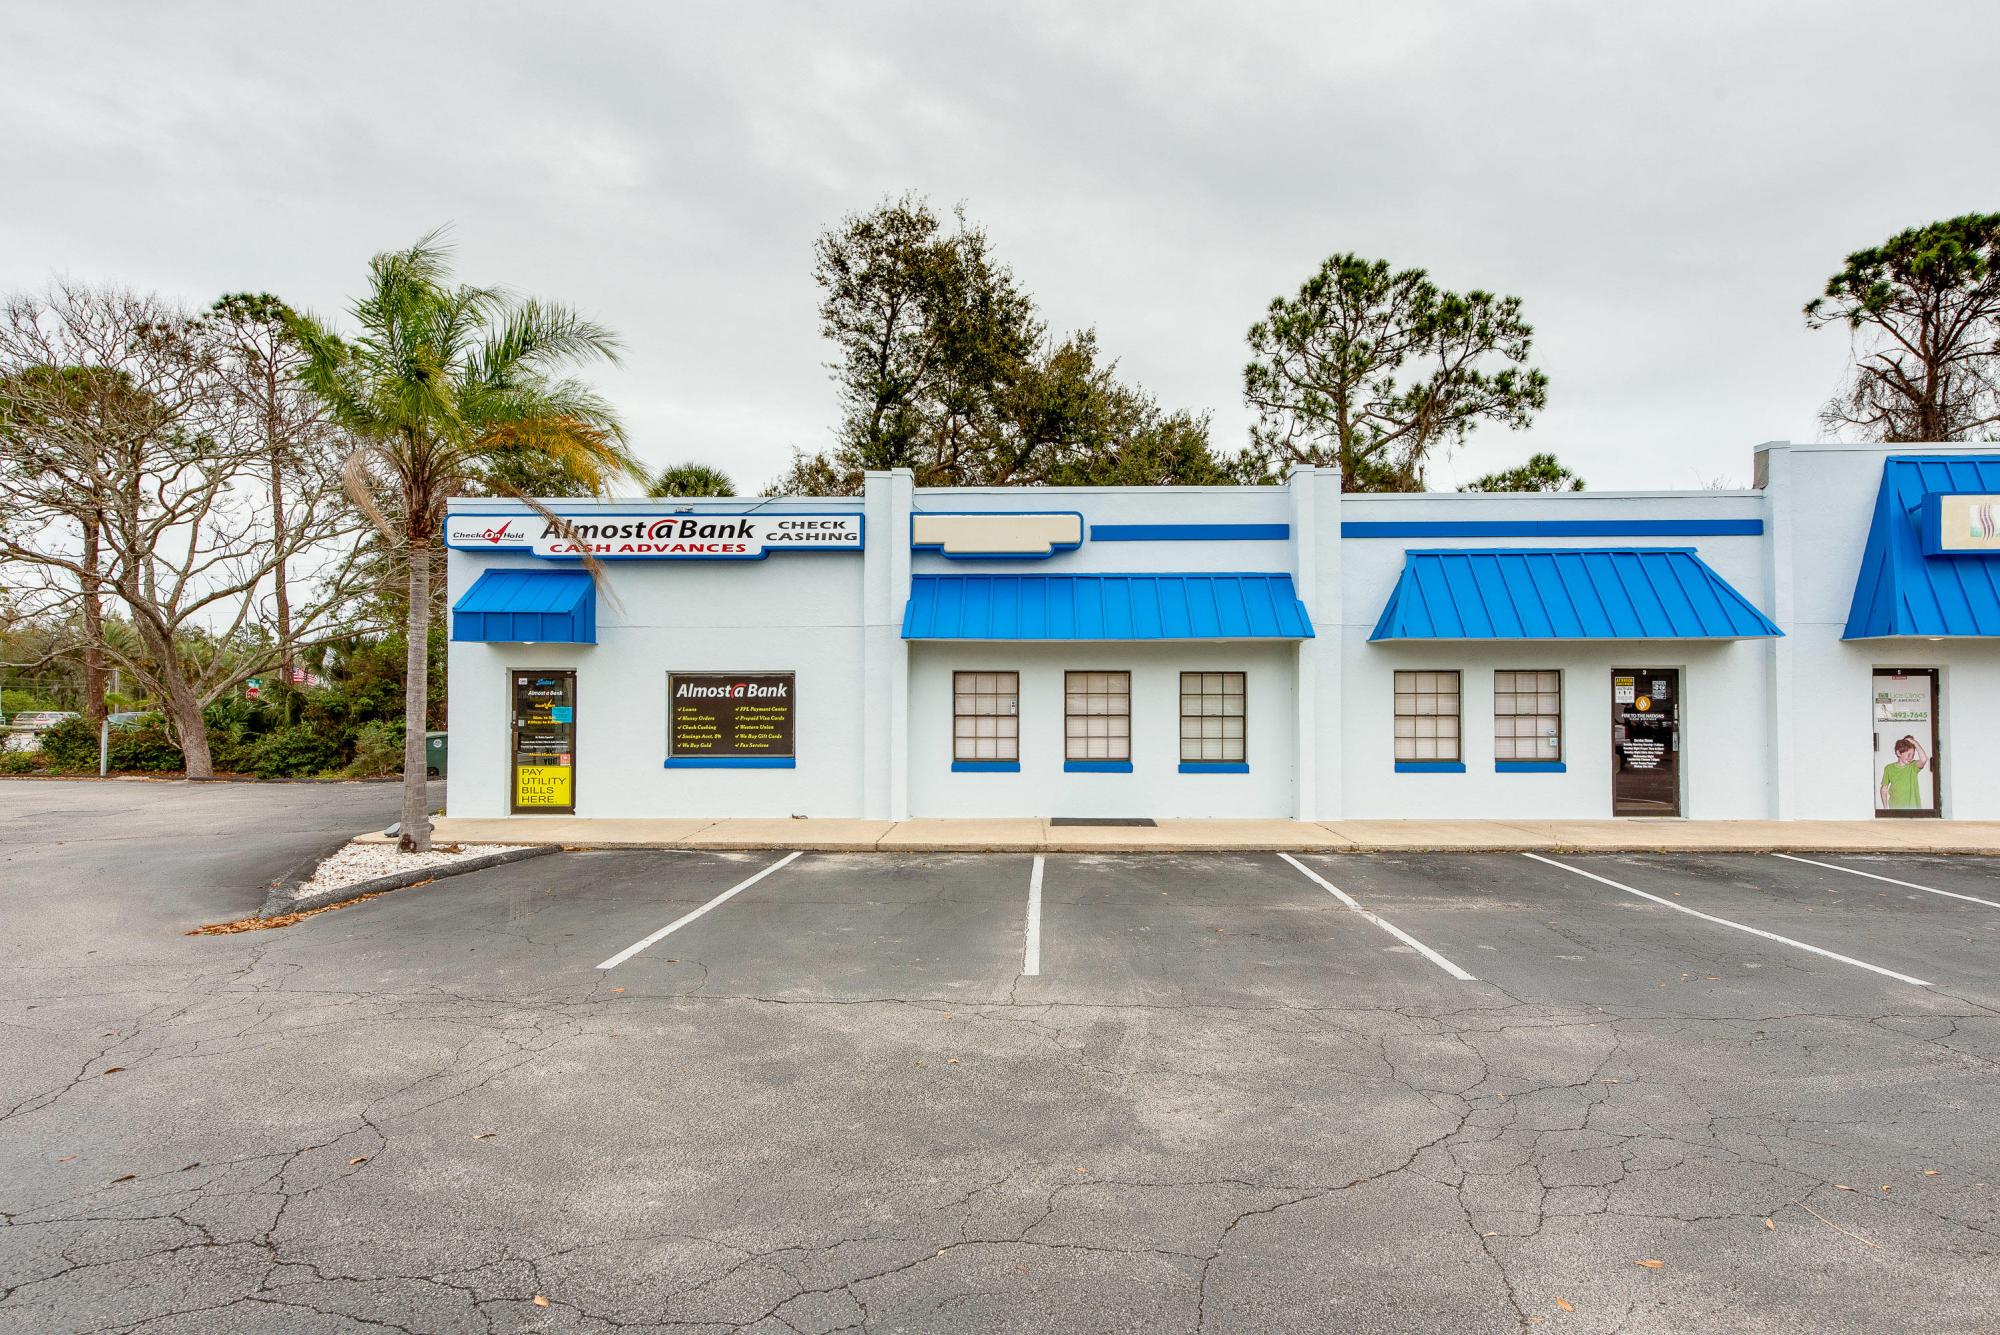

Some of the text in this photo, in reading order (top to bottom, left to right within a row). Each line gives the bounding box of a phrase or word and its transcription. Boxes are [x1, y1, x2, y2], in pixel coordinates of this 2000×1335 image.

[540, 519, 756, 539] Almost a Bank
[777, 521, 847, 530] CHECK
[452, 531, 525, 539] Check On Hold
[765, 532, 858, 541] CASHING
[549, 543, 746, 553] CASH ADVANCES
[676, 682, 788, 698] Almost a Bank
[522, 768, 544, 776] PAY
[521, 777, 566, 785] UTILITY
[521, 786, 554, 794] BILLS
